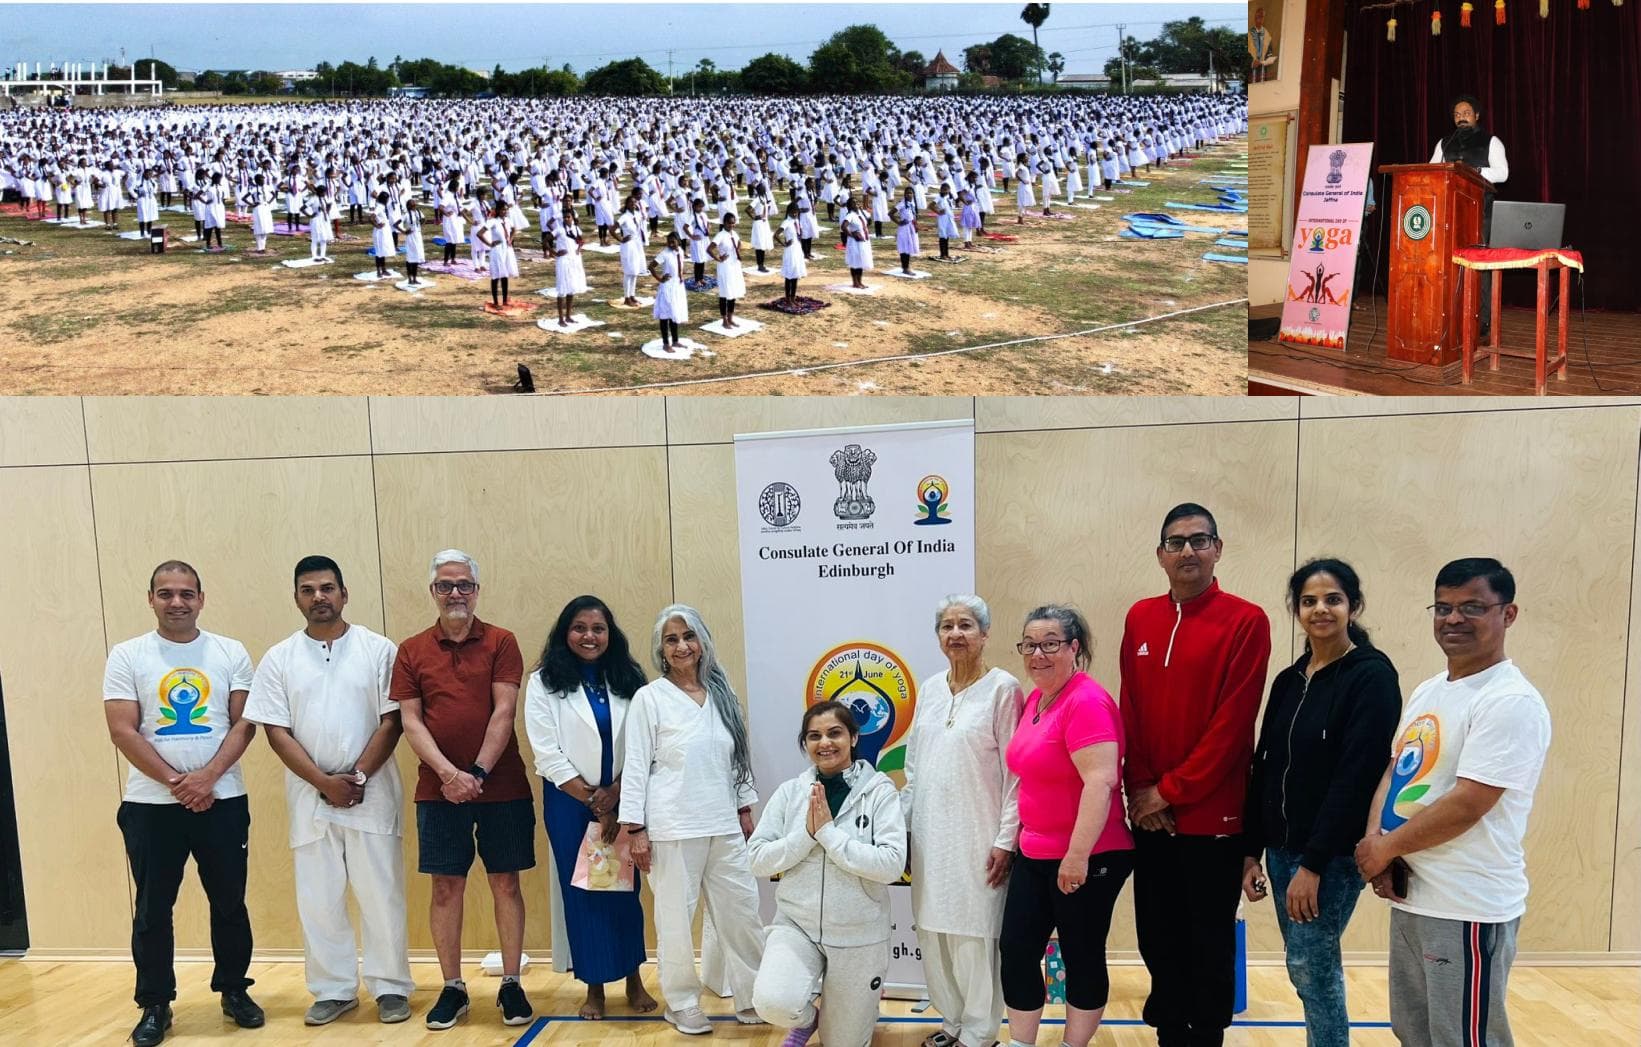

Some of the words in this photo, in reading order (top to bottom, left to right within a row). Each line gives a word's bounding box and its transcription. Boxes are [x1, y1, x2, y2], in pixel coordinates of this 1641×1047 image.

[759, 545, 829, 560] Consulate
[832, 541, 889, 557] General
[893, 540, 914, 555] Of
[917, 538, 955, 554] India
[818, 562, 895, 580] Edinburgh
[863, 650, 885, 665] day
[885, 661, 898, 671] of
[892, 671, 908, 699] yoga
[863, 670, 884, 679] June
